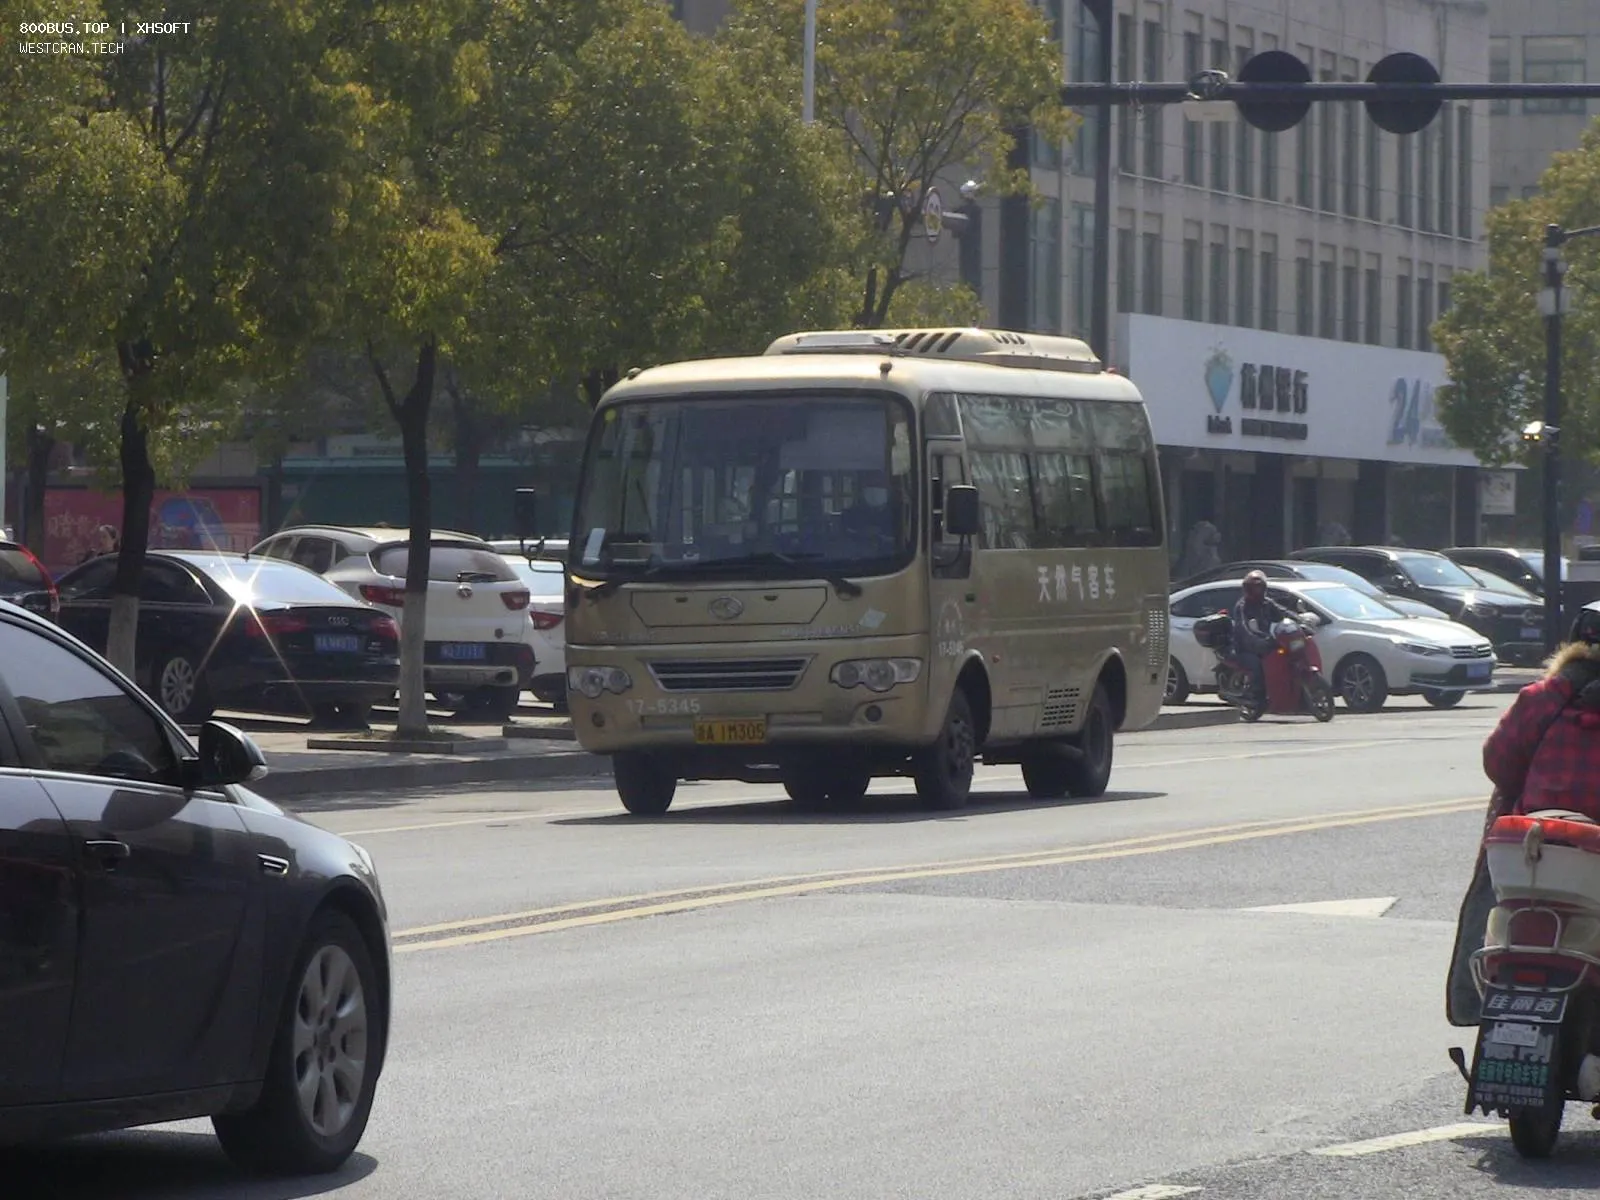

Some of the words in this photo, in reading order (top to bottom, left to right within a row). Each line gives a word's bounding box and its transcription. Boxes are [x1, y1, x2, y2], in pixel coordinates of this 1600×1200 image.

[1037, 562, 1116, 602] 天然气客车
